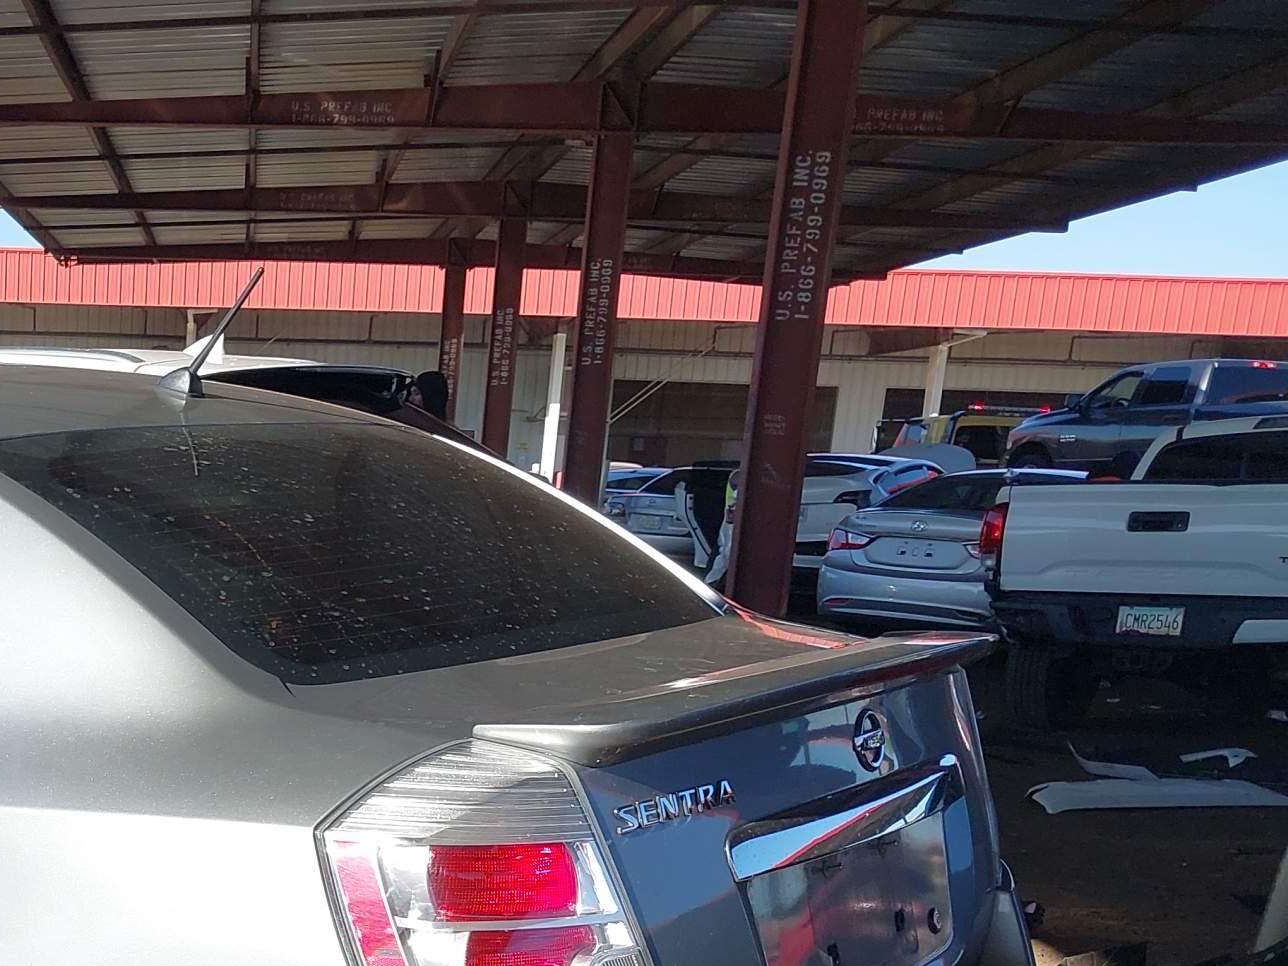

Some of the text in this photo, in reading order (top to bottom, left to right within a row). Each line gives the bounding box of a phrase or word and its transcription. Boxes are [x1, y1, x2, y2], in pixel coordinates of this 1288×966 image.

[775, 150, 813, 320] U.S. PREFAB INC.
[794, 151, 832, 319] 1-866-799-0969
[584, 288, 598, 335] PREFAB
[1125, 613, 1179, 630] CMR2546
[614, 779, 737, 835] SENTRA
